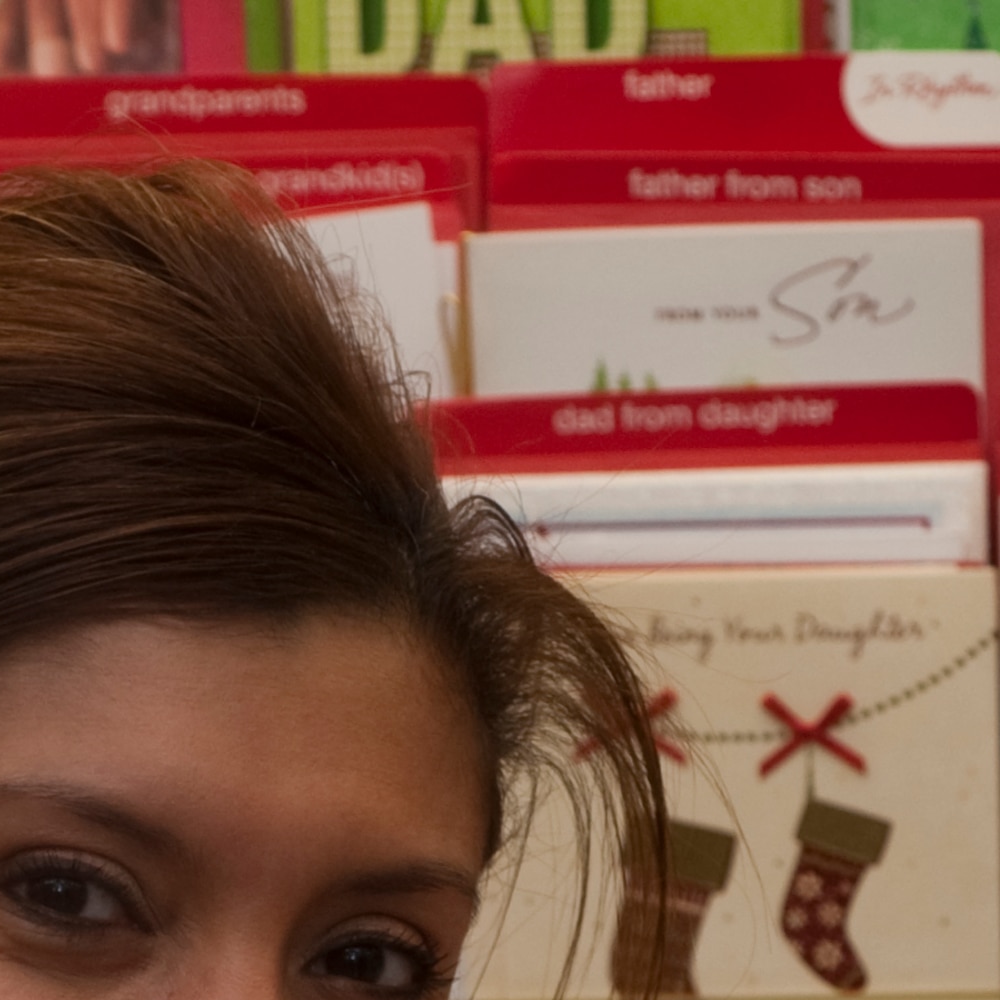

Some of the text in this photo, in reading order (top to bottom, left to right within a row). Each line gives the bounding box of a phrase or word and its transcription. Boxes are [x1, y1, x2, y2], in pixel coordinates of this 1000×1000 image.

[104, 84, 307, 121] grandparents
[623, 68, 715, 100] father
[627, 168, 862, 201] father from son
[768, 253, 916, 348] Son
[552, 396, 837, 435] dad from daughter
